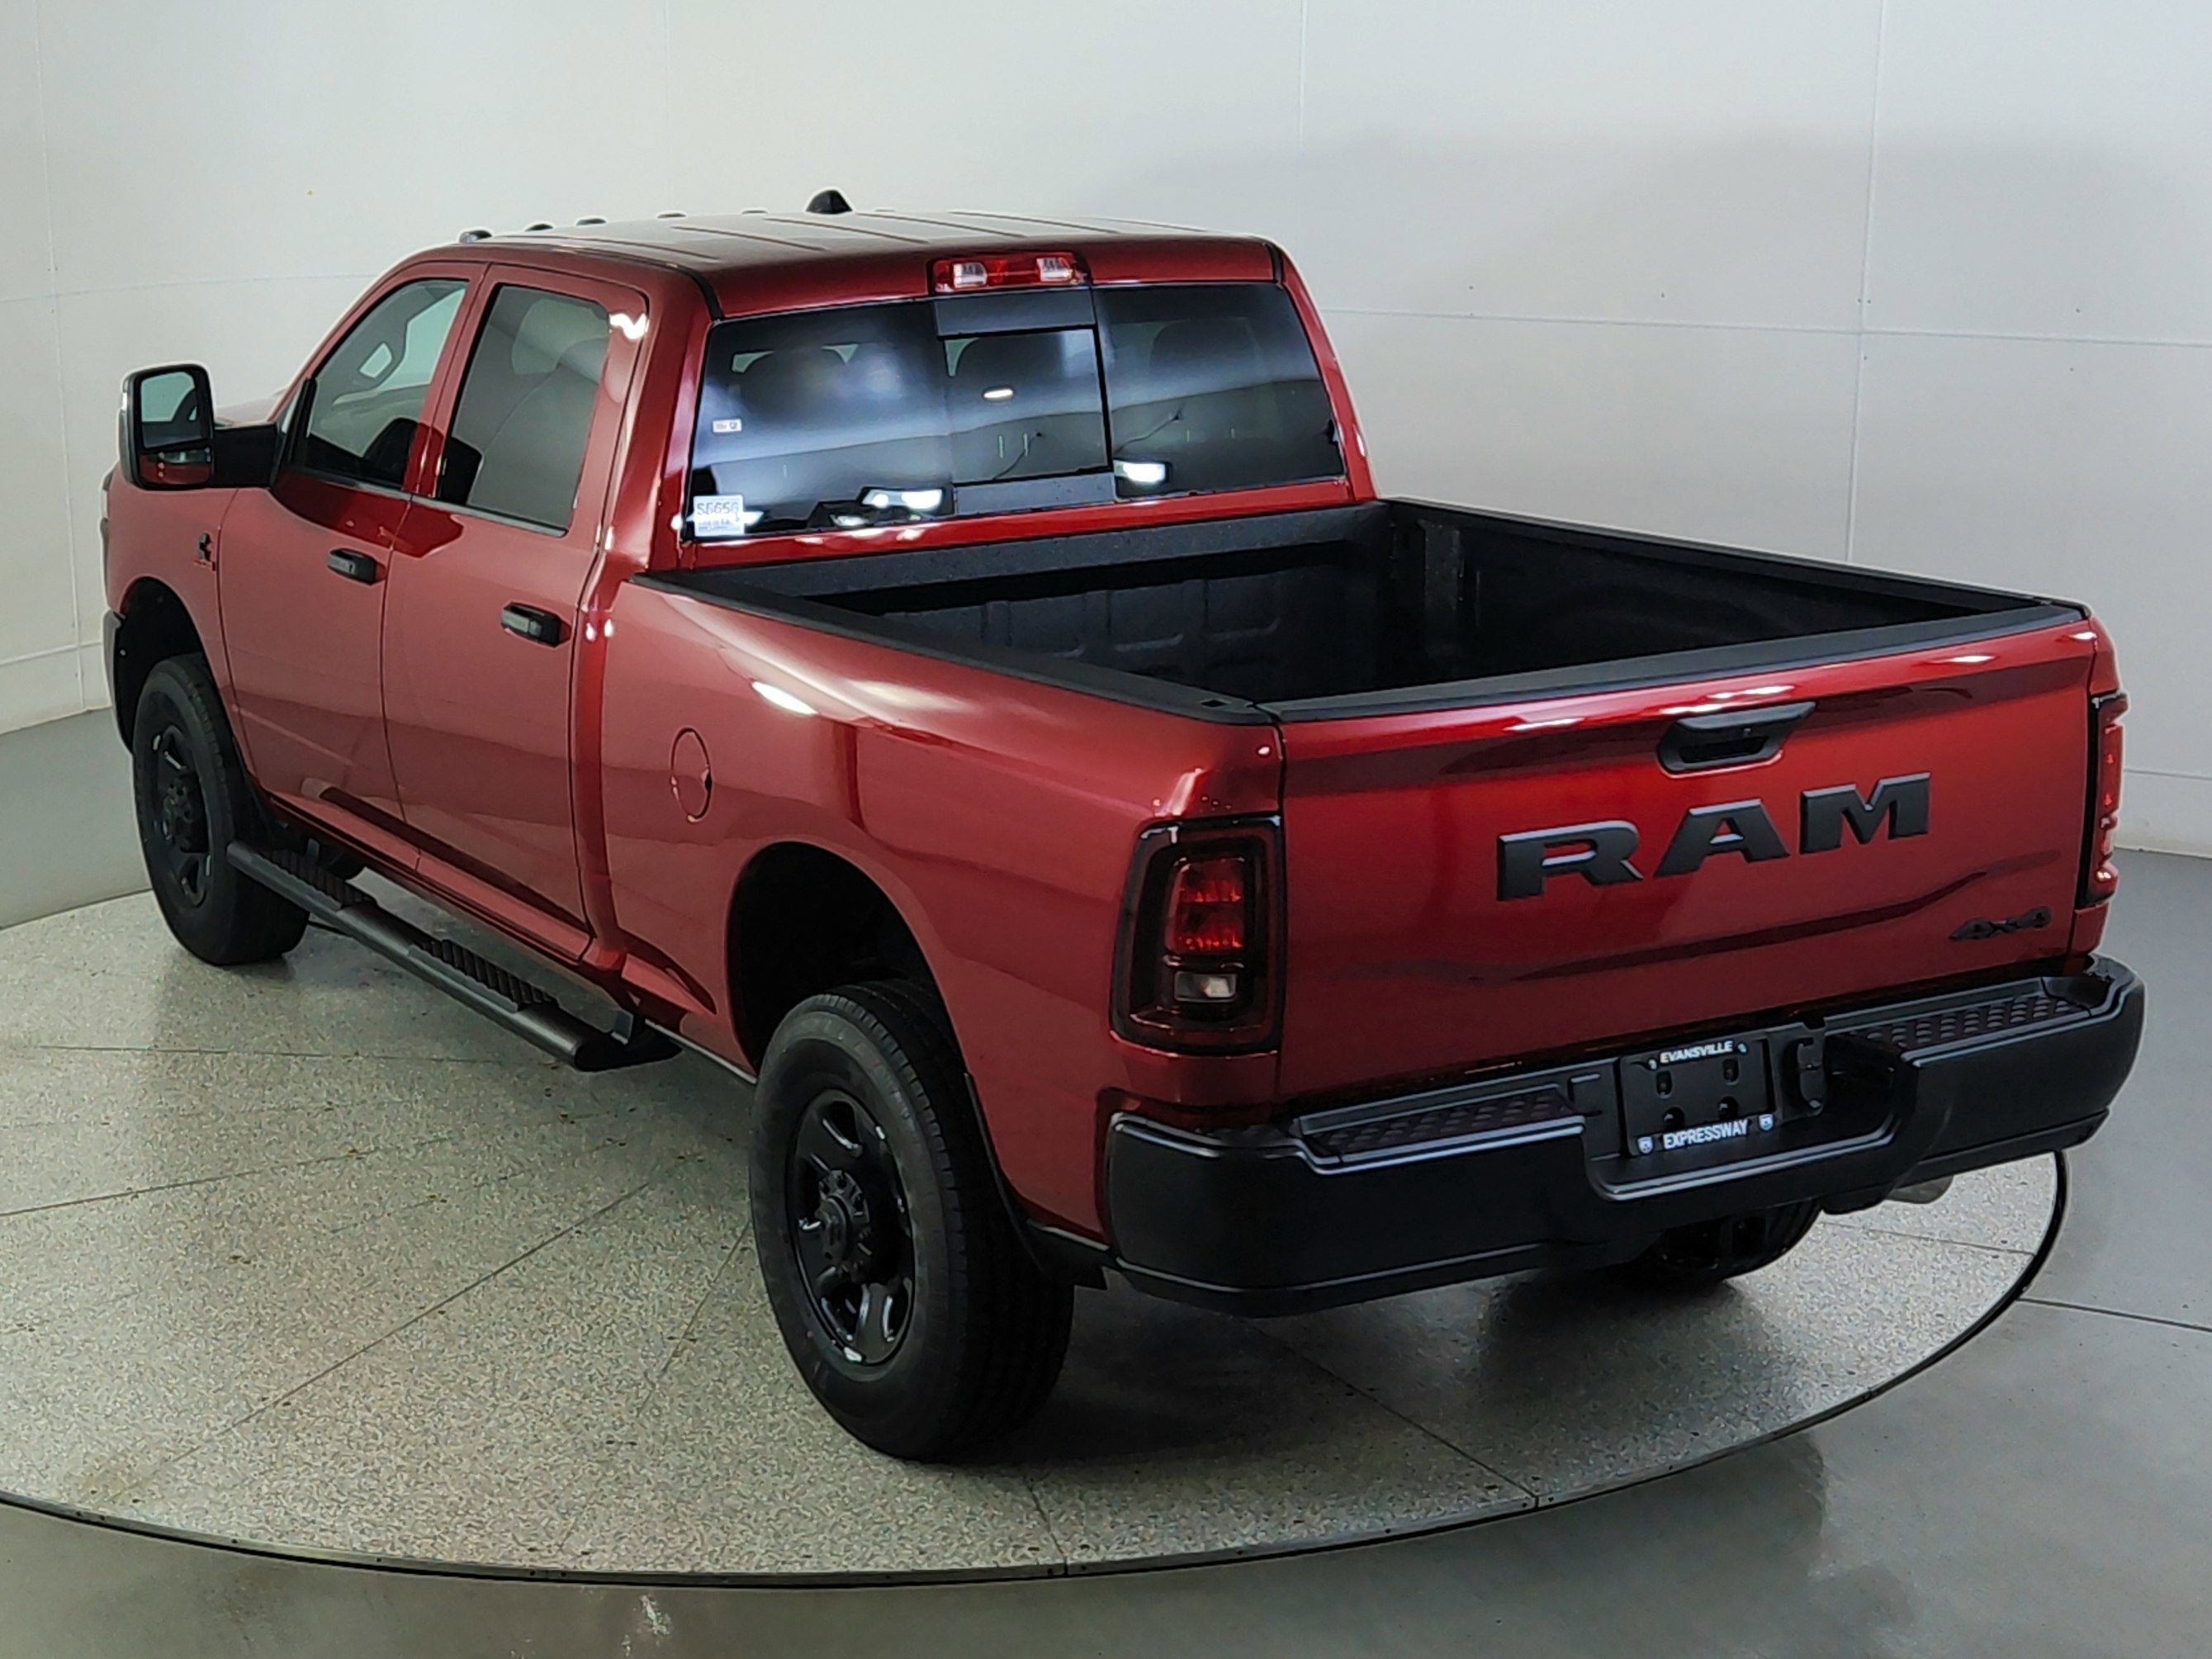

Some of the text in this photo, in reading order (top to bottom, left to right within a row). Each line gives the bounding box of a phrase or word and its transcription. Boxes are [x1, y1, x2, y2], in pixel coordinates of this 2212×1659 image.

[1497, 772, 1930, 901] RAM
[1660, 1040, 1733, 1064] EVANSVILLE
[1663, 1119, 1748, 1149] EXPRESSWAY
